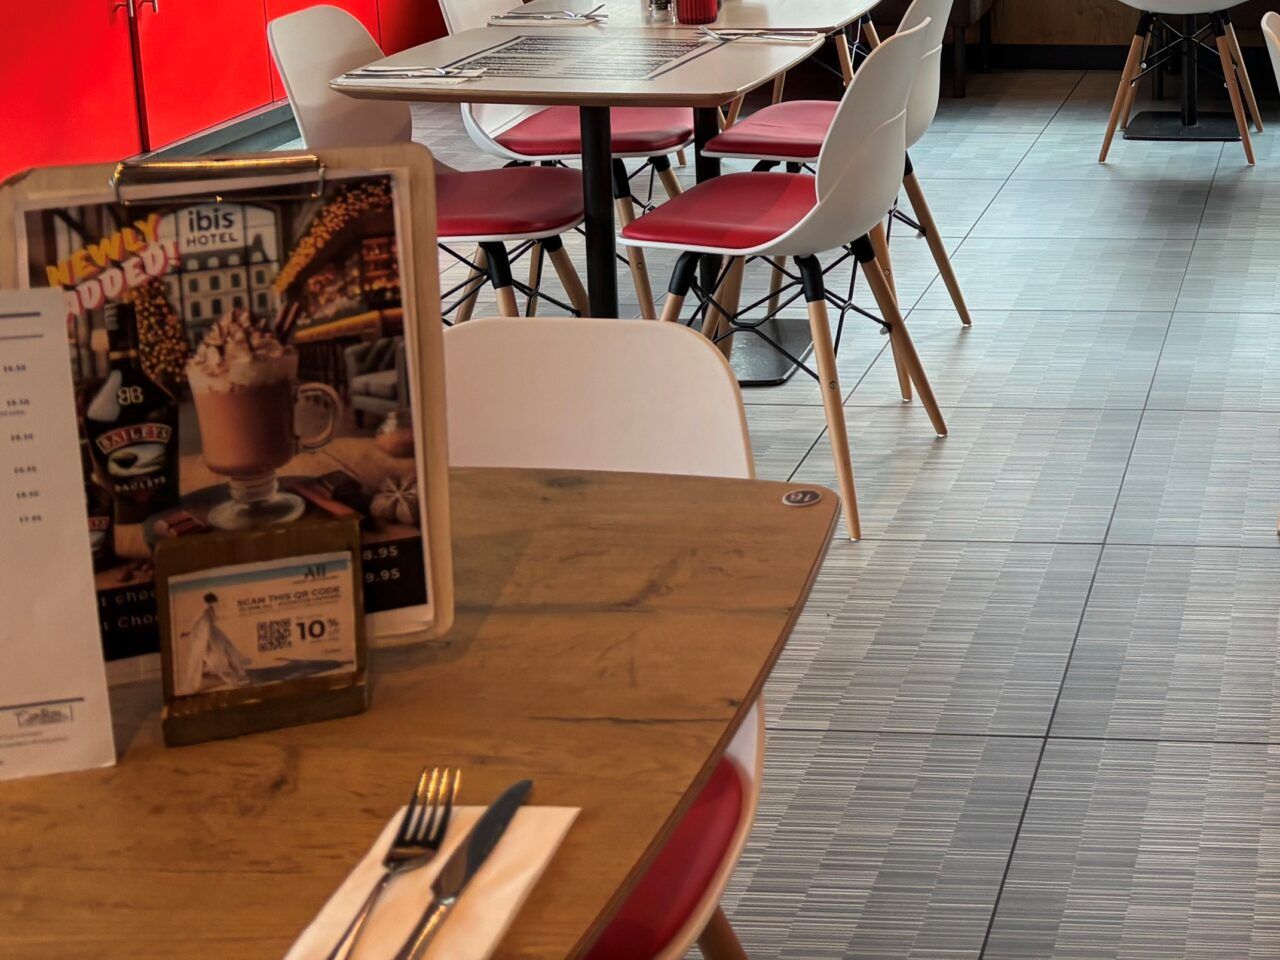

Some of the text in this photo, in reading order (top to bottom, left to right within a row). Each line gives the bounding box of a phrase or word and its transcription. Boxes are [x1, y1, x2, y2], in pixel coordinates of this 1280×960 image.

[187, 207, 236, 231] ibis
[46, 212, 161, 288] NEWLY
[186, 231, 238, 248] HOTEL
[64, 239, 181, 317] ADDED!
[237, 585, 341, 608] SCAN THIS QR CODE
[296, 619, 326, 640] 10
